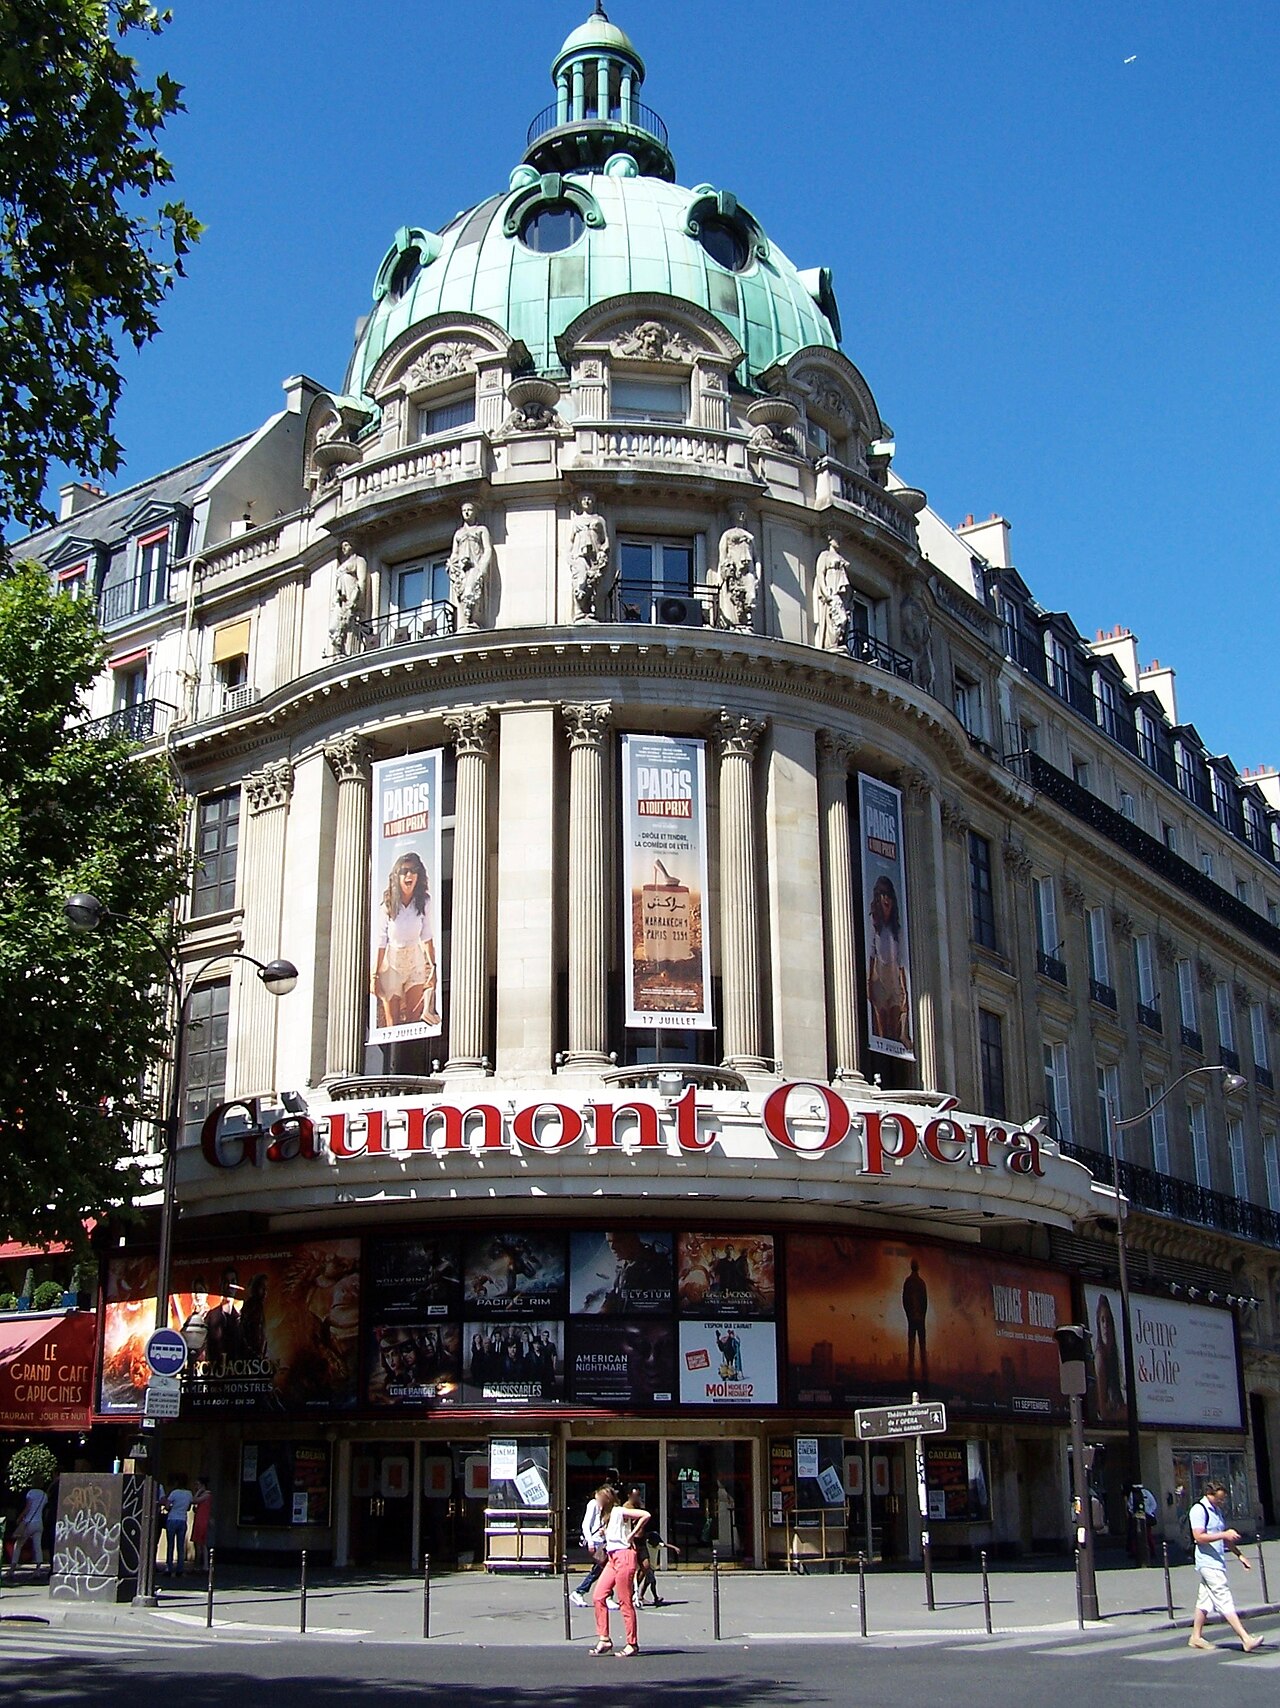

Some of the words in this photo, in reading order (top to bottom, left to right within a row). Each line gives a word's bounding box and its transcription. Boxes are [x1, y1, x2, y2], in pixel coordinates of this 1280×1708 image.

[640, 801, 646, 815] A
[646, 801, 664, 815] TOUT
[665, 801, 690, 817] PRIX
[406, 812, 427, 832] PRIX
[643, 1016, 654, 1024] 17
[659, 1017, 696, 1026] JUILLET
[382, 1032, 392, 1040] 17
[396, 1026, 427, 1038] JUILLET
[201, 1083, 718, 1169] Gaumont
[761, 1082, 1046, 1177] Opéra
[621, 1289, 671, 1299] ELYSIUM
[529, 1298, 551, 1306] RIM
[1135, 1308, 1177, 1349] Jeune
[44, 1344, 58, 1361] LE
[576, 1354, 628, 1363] AMERICAN
[10, 1363, 51, 1381] GRAND
[576, 1363, 628, 1372] NIGHTMARE
[14, 1385, 82, 1403] CAPUCINES
[223, 1382, 274, 1393] MONSTRES
[389, 1387, 407, 1396] LONE
[706, 1382, 727, 1397] MOI
[747, 1384, 754, 1397] 2
[928, 1449, 962, 1460] CADEAUX
